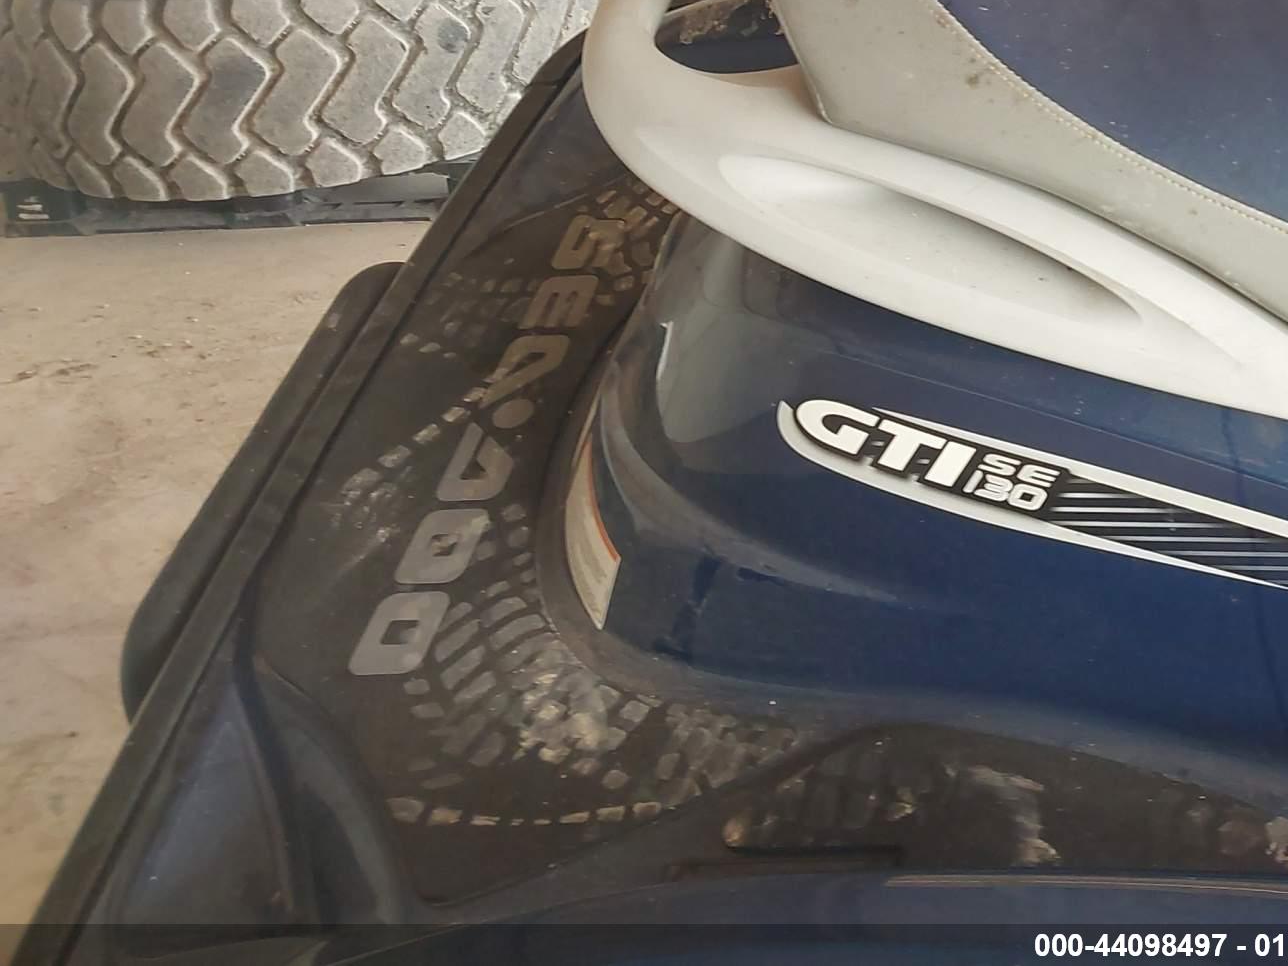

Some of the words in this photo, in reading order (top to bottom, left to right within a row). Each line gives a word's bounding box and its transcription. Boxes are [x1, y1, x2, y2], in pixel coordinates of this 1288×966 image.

[796, 399, 976, 487] GTI
[962, 470, 1048, 512] 130
[978, 453, 1061, 488] SE
